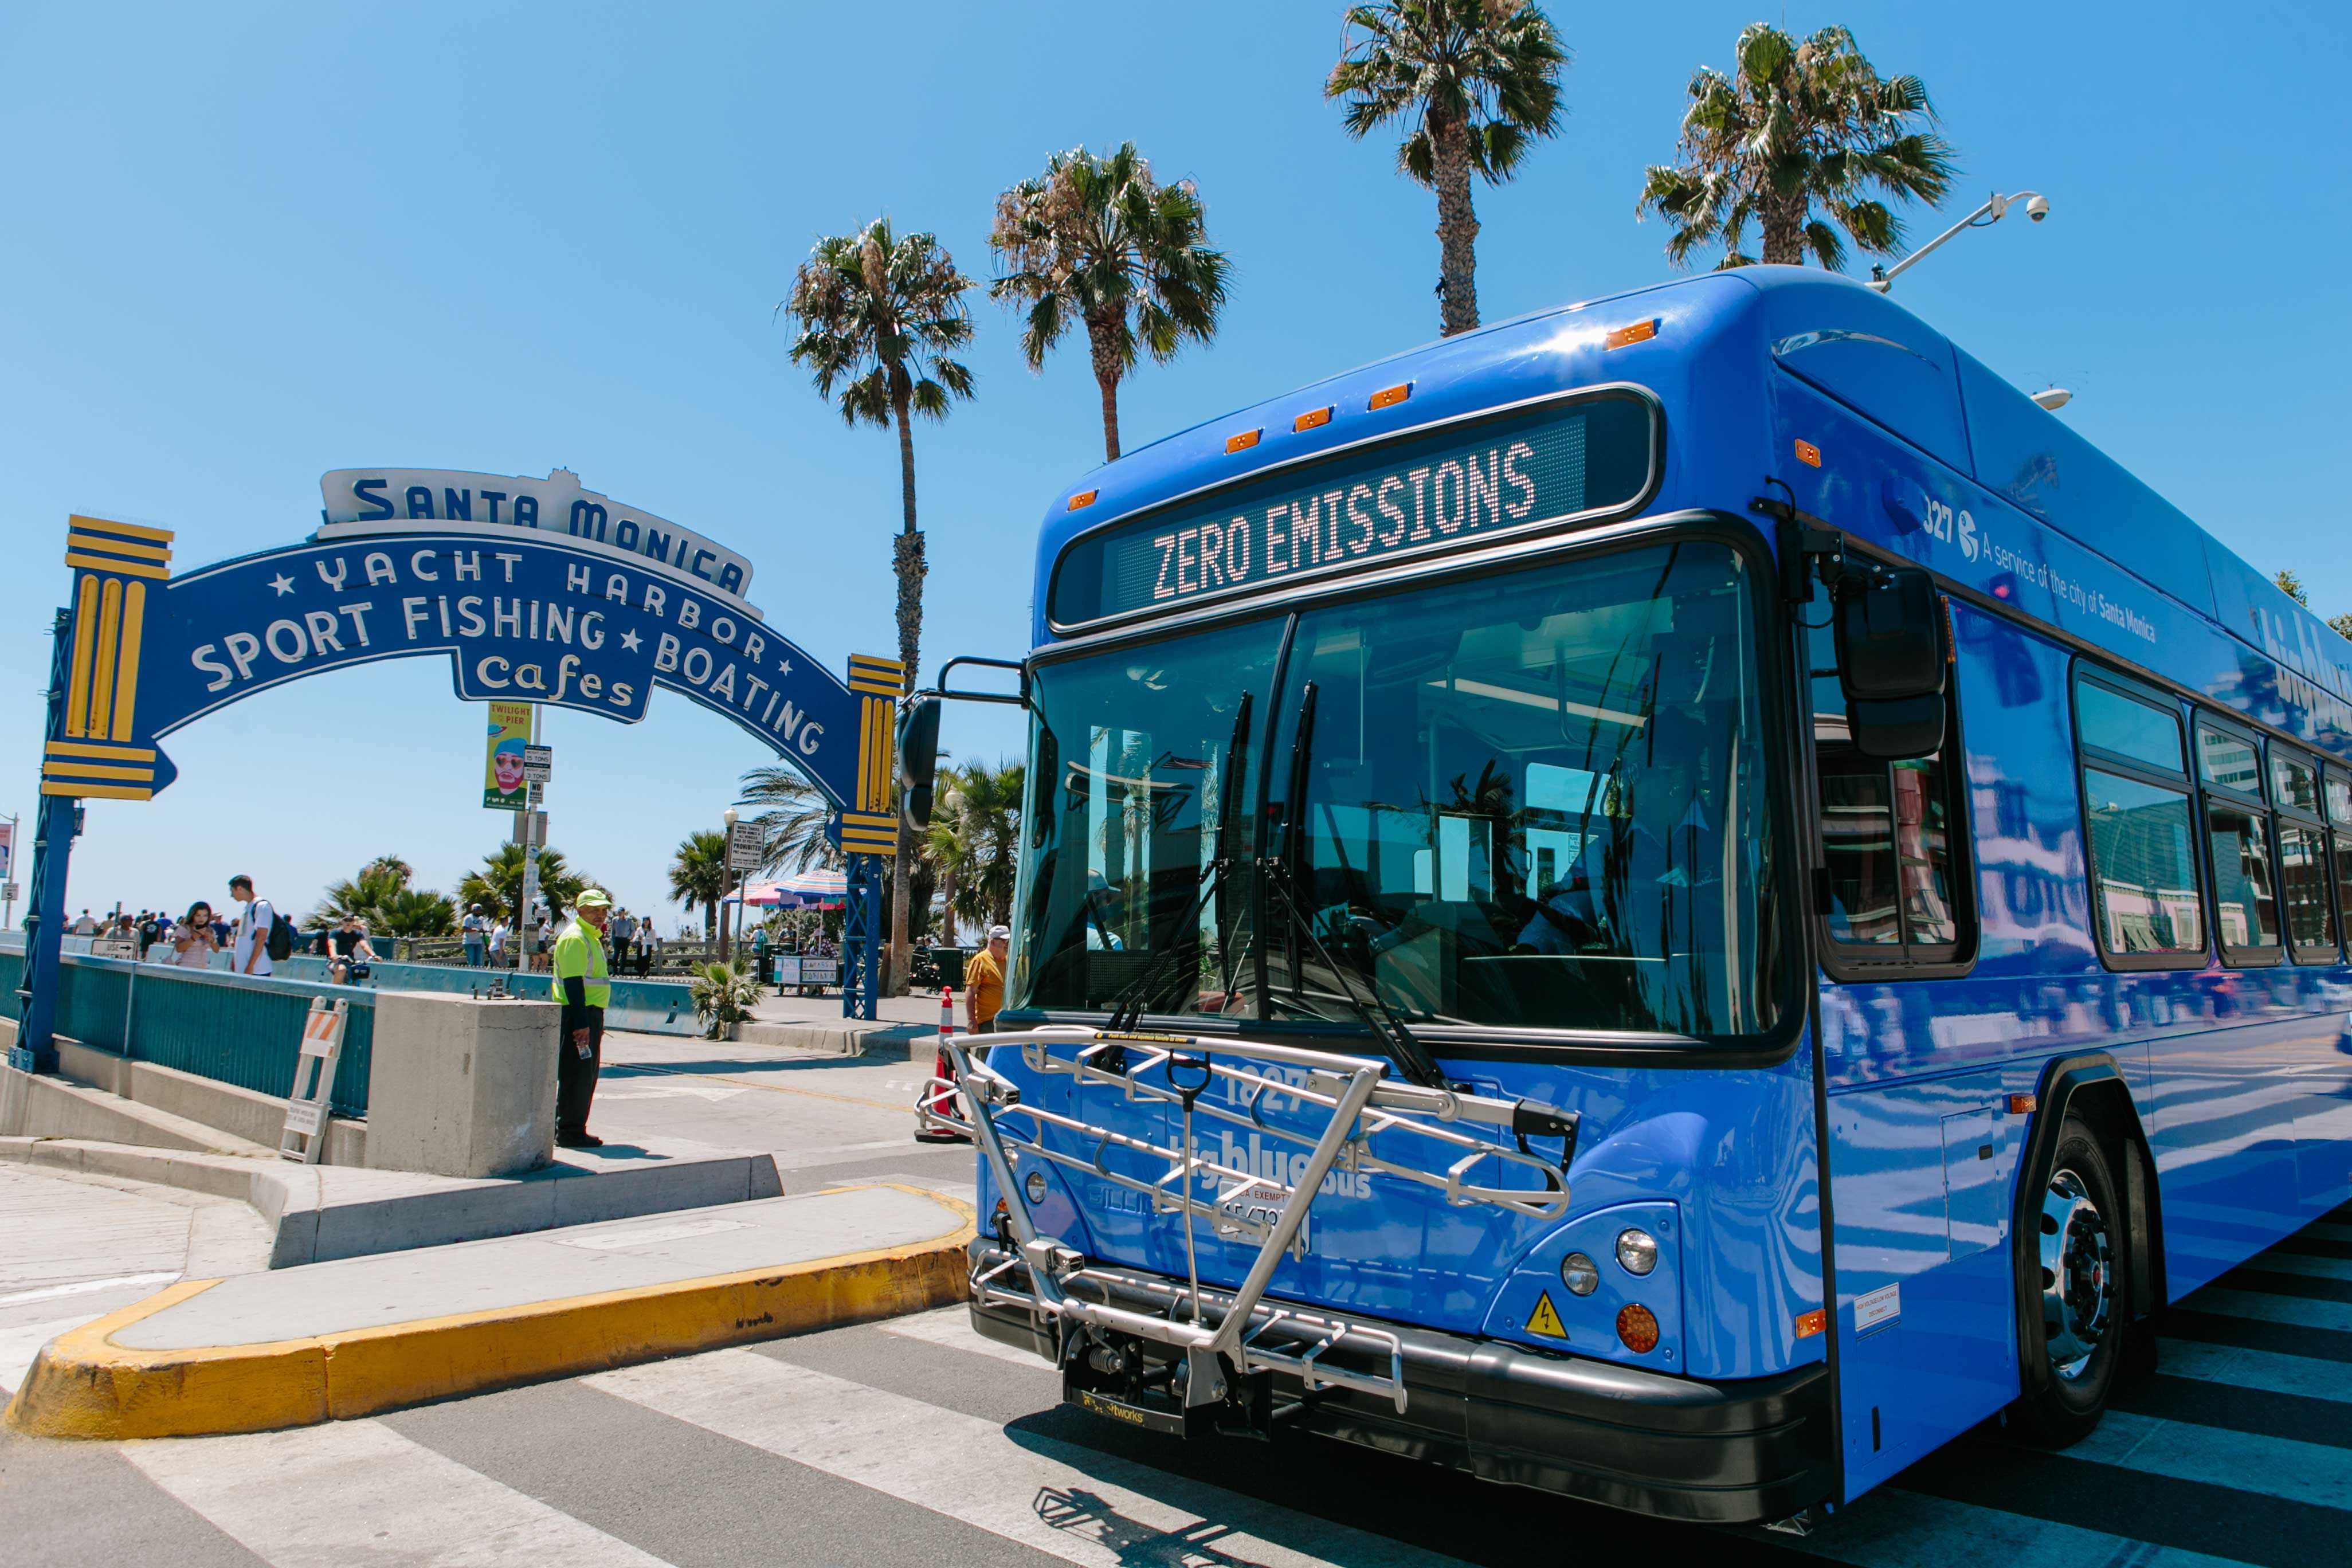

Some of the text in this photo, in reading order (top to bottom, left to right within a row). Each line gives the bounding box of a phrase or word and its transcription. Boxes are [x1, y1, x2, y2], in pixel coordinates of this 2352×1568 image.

[353, 479, 744, 598] SANTA MONICA
[1153, 441, 1536, 599] ZERO EMISSIONS
[316, 549, 765, 664] YACHT HARBOR
[1983, 532, 2155, 644] A service of the city of Santa Monica
[191, 595, 825, 755] SPORT FISHING BOATING
[491, 704, 530, 716] TWILIGHT
[506, 716, 524, 724] PIER
[734, 843, 761, 851] PROHIBITED
[1221, 1064, 1307, 1112] 1827
[1255, 1191, 1285, 1202] EXEMPT
